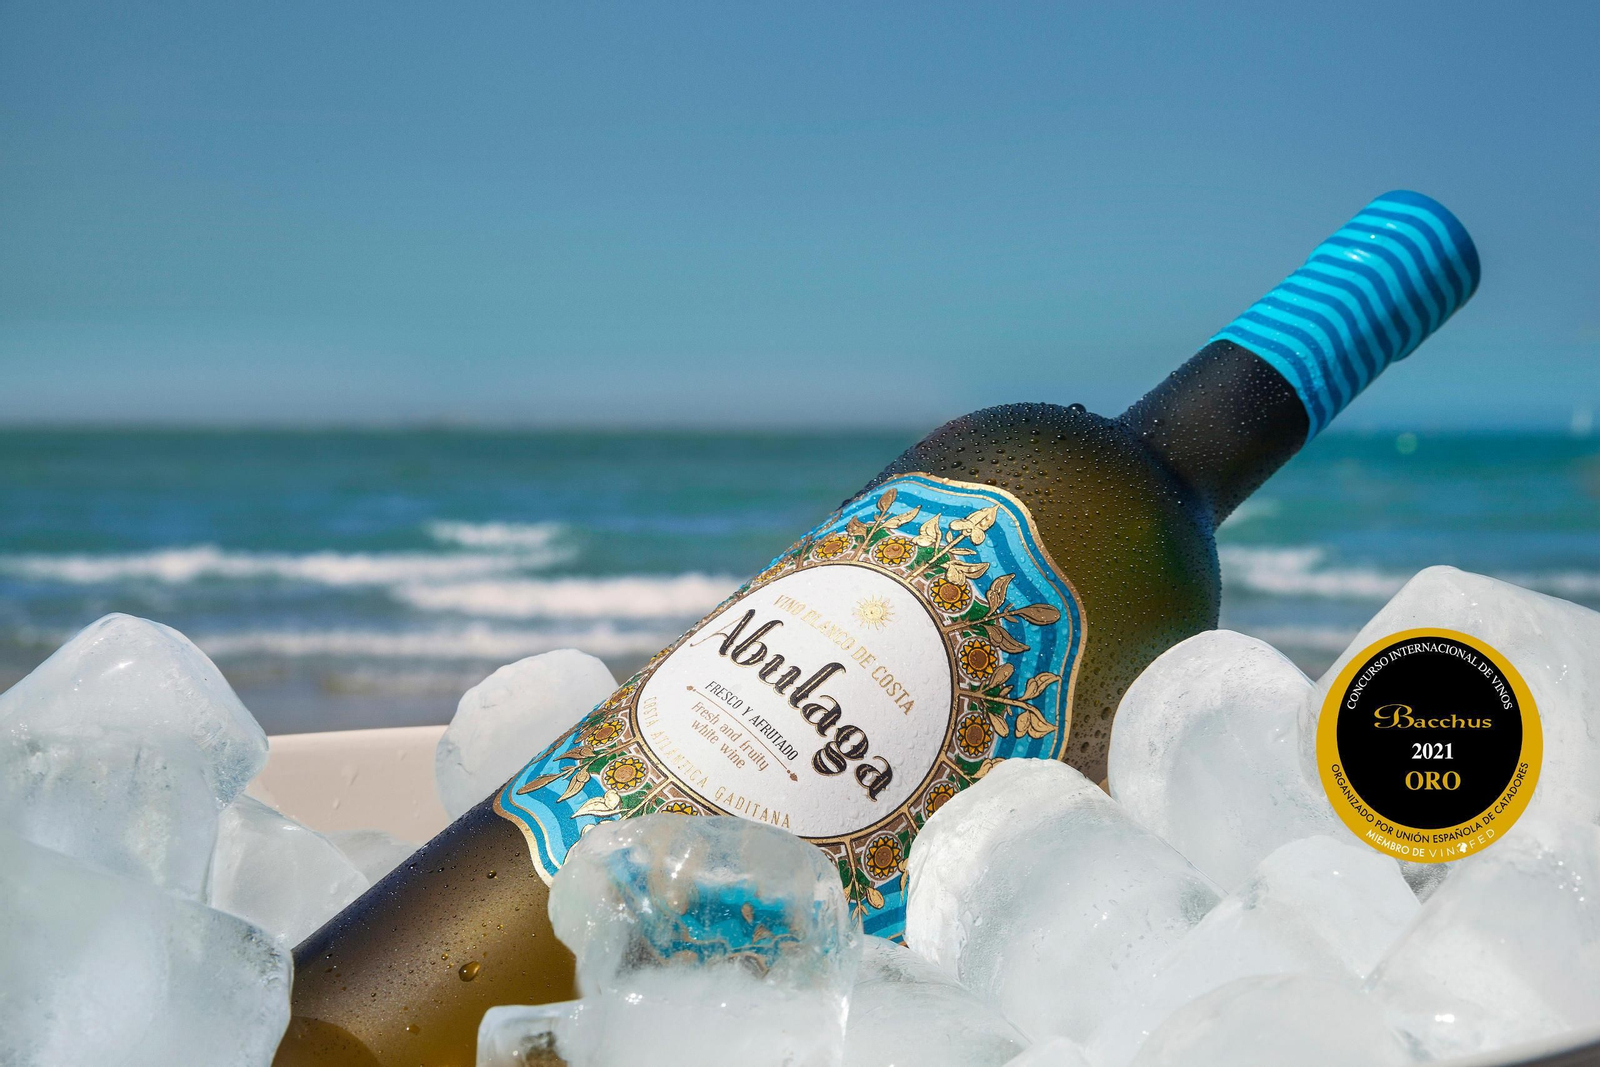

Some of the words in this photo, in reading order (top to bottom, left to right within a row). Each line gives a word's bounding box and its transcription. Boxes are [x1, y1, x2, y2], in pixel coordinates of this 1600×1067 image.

[774, 595, 806, 615] VINO
[801, 609, 856, 650] BLANCO
[851, 646, 876, 669] DE
[871, 666, 915, 715] COSTA
[690, 609, 894, 802] Abulaga
[691, 719, 718, 745] white
[720, 744, 745, 770] wine
[705, 680, 742, 709] FRESCO
[741, 704, 753, 717] Y
[748, 714, 798, 761] AFRUTADO
[720, 721, 743, 742] and
[738, 739, 770, 772] fruity
[643, 696, 660, 728] COSTA
[714, 785, 791, 828] GADITANA
